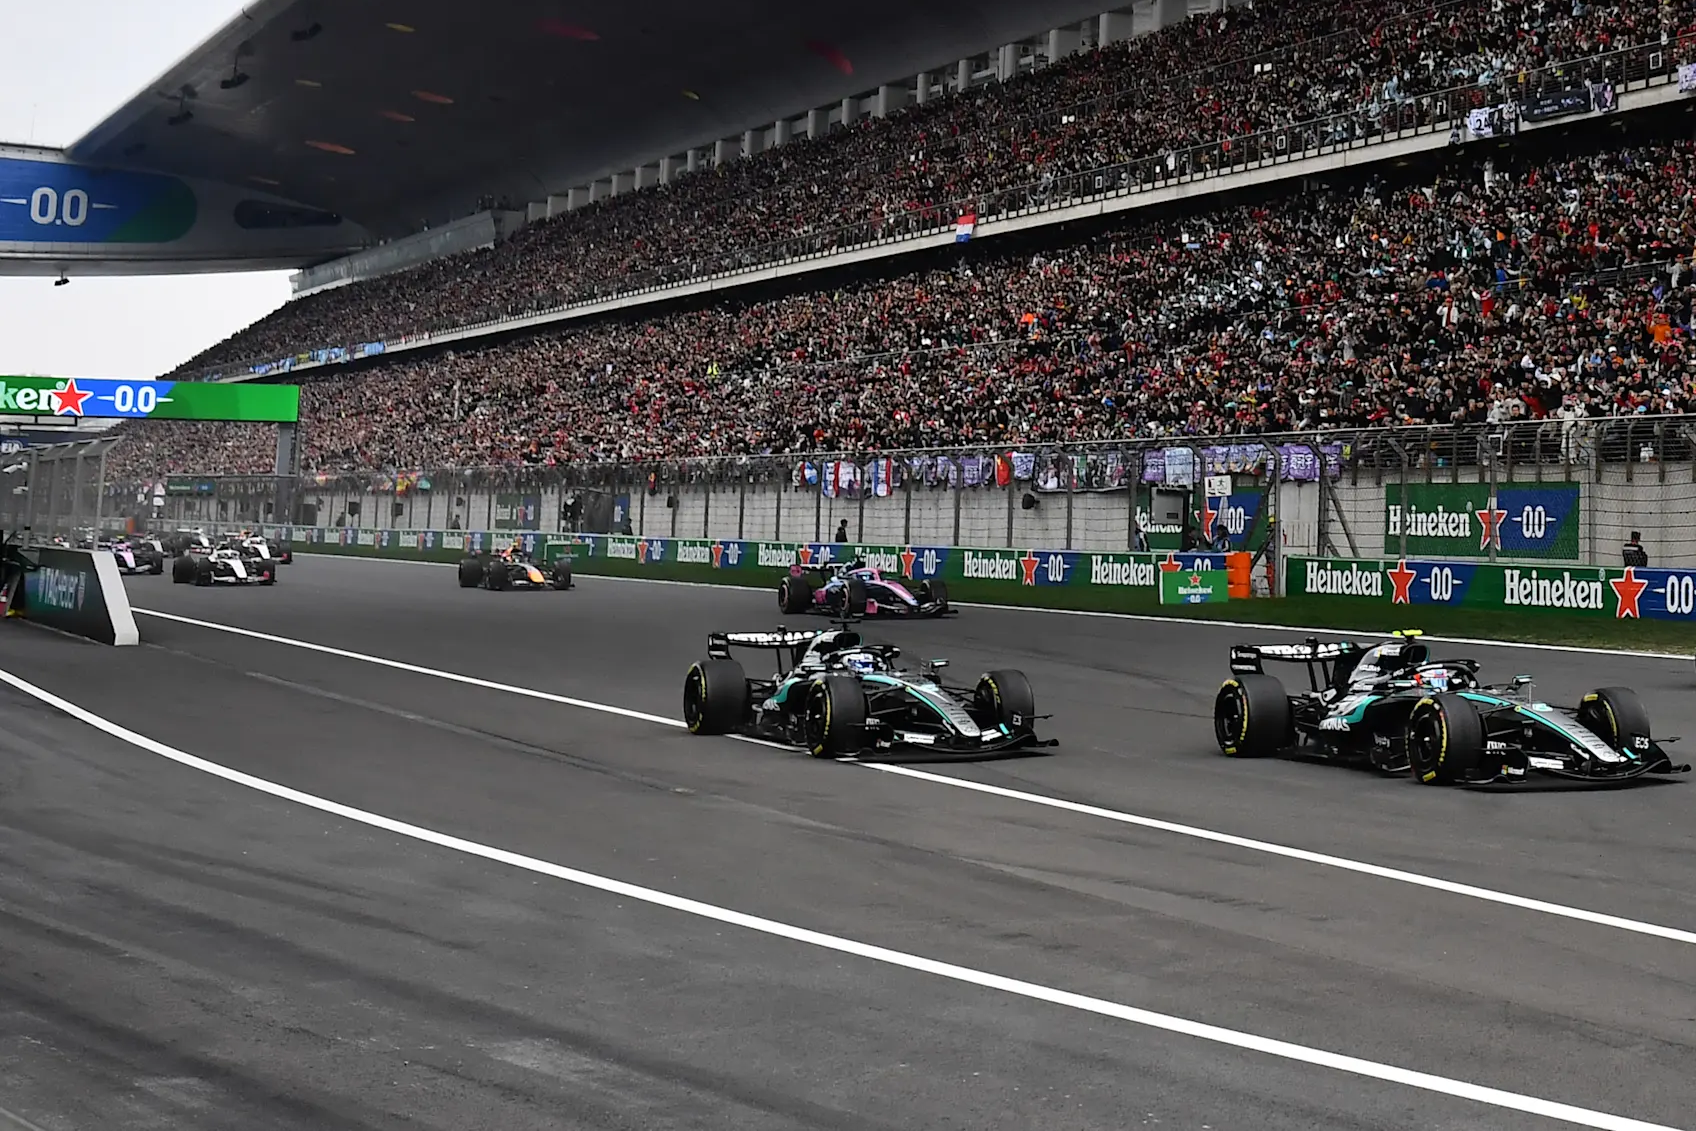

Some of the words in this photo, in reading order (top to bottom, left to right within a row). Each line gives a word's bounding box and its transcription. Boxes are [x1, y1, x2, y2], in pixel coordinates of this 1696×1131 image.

[30, 186, 88, 226] 0.0
[114, 385, 156, 413] 0.0
[1522, 505, 1546, 539] 0.0
[855, 547, 897, 573] ineken
[963, 551, 1016, 580] Heineken
[1048, 554, 1064, 582] 0.0
[1091, 555, 1155, 586] Heineken
[1305, 561, 1383, 596] Heineken
[1430, 566, 1452, 601] 0.0
[1504, 569, 1603, 610] Heineken
[1665, 575, 1694, 615] 0.0
